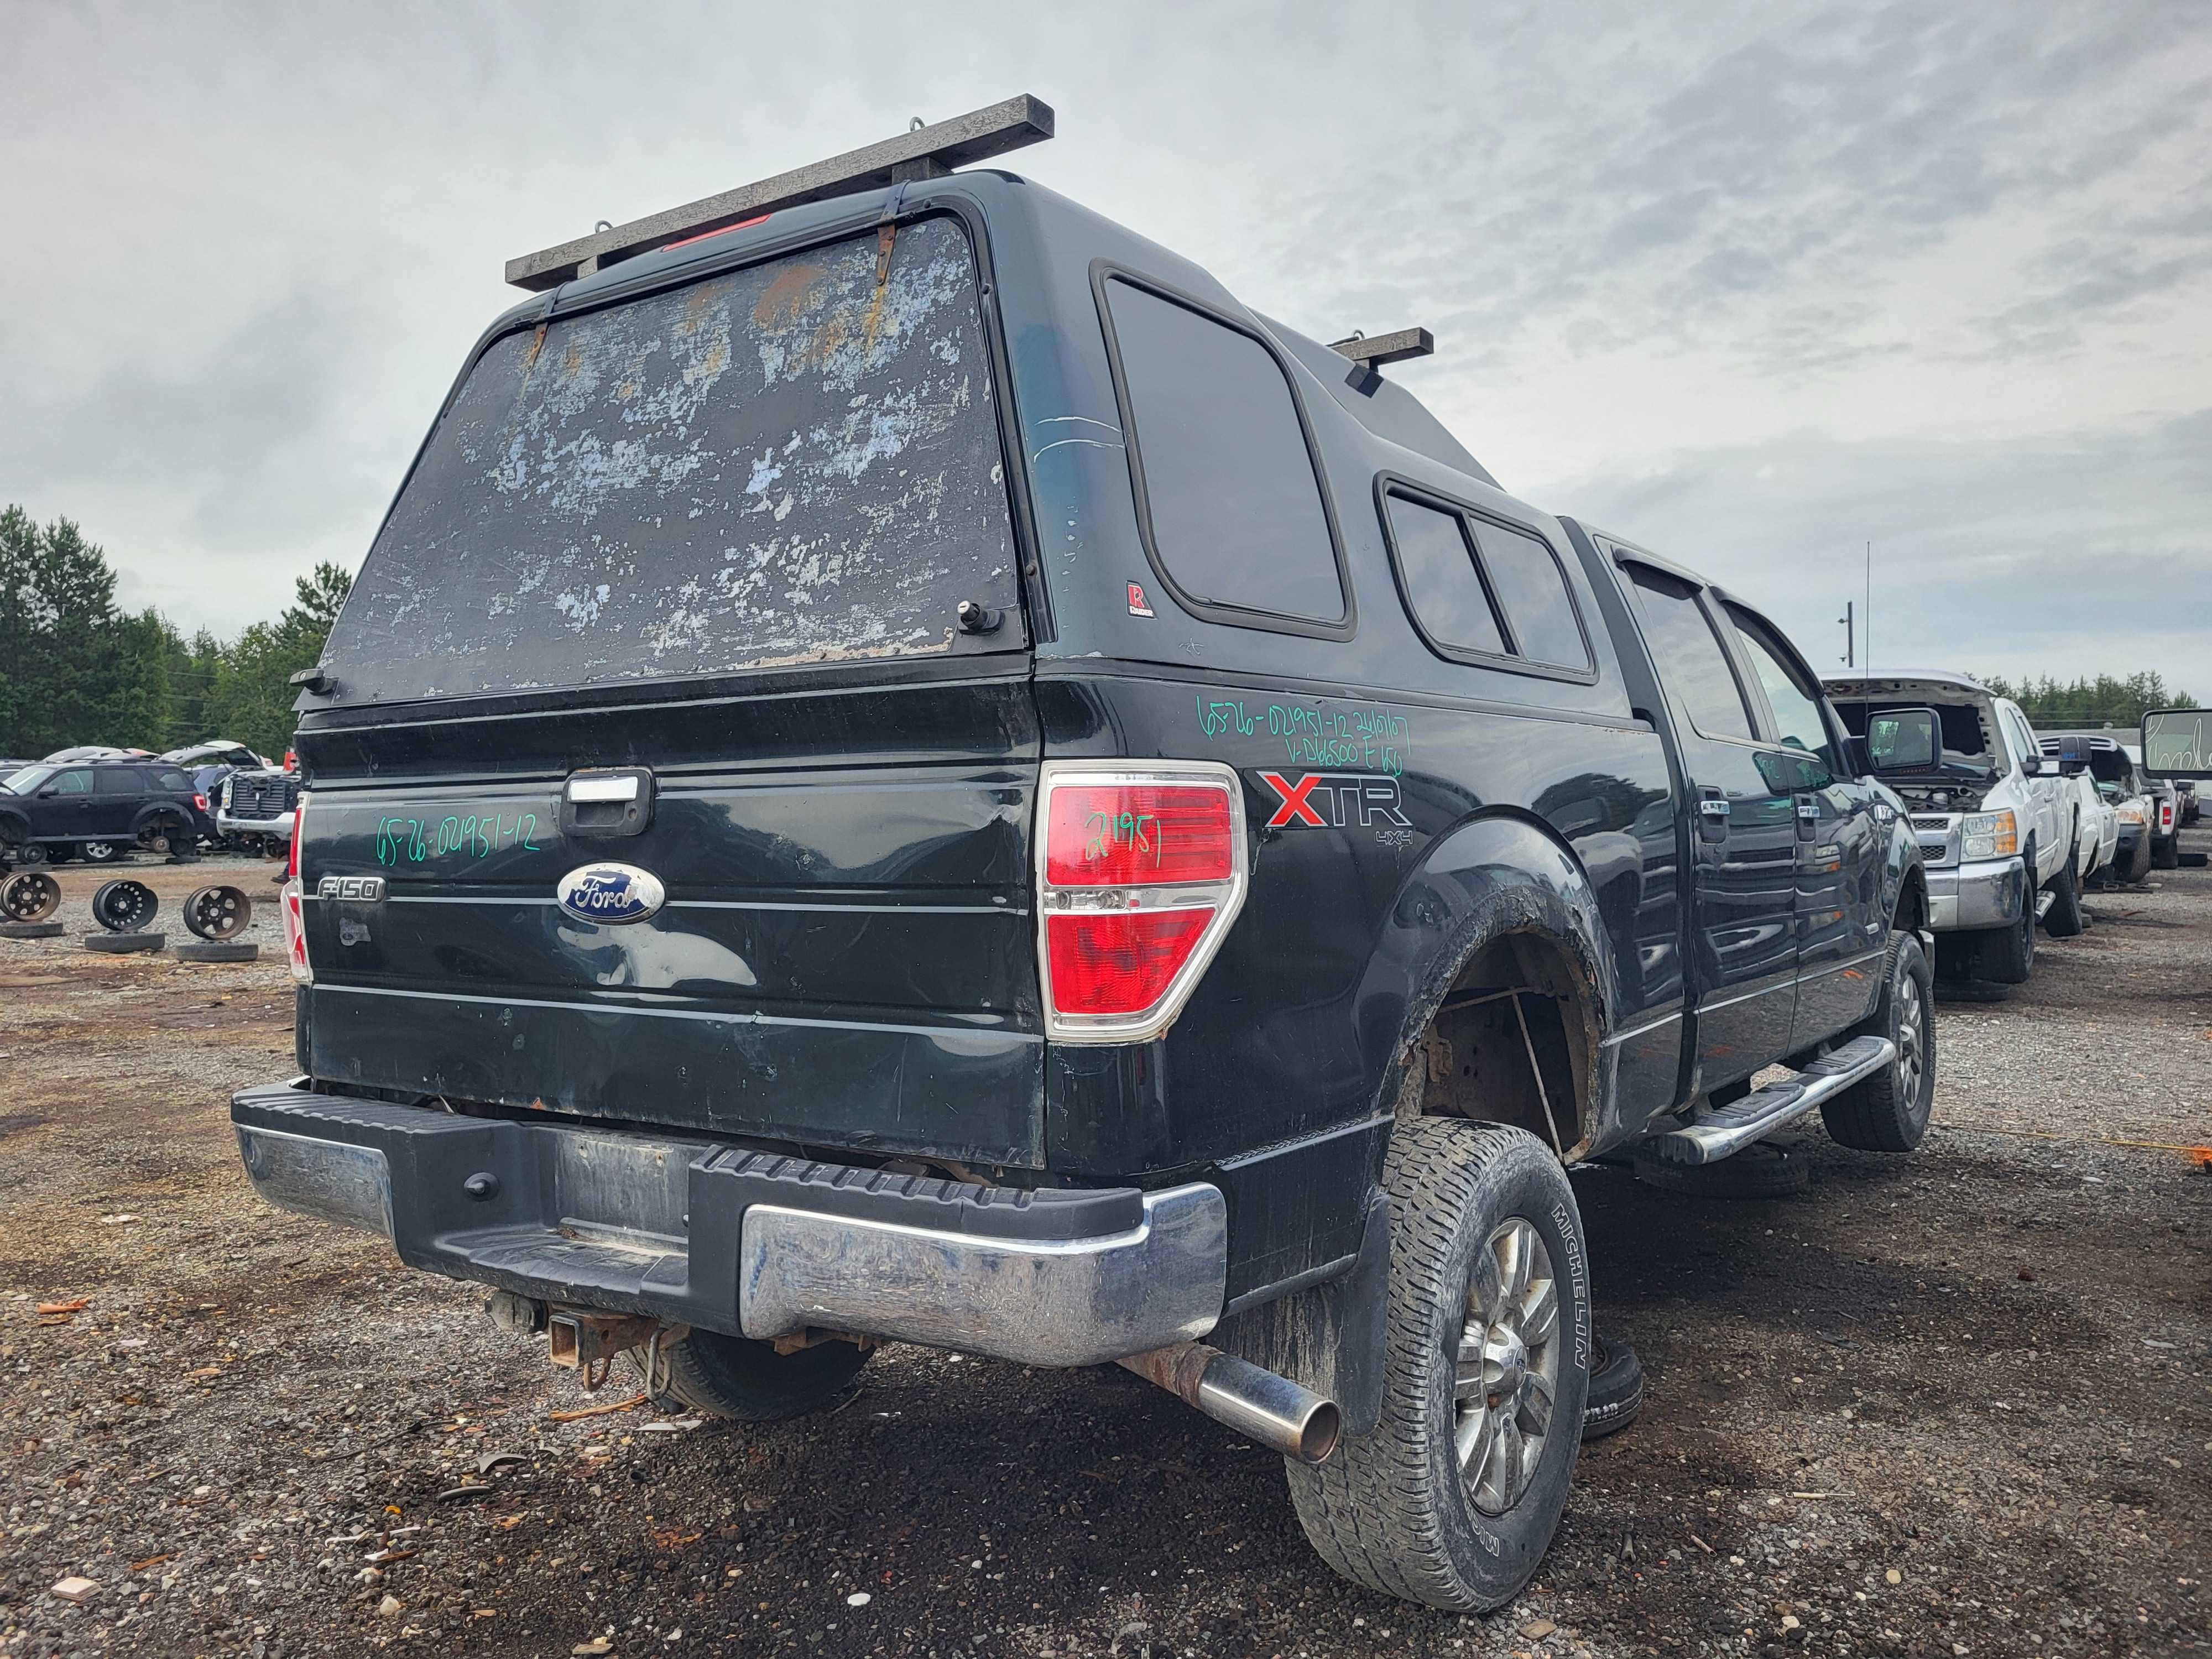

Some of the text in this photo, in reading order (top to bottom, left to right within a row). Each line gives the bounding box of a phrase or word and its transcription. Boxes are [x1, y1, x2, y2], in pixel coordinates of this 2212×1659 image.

[1129, 606, 1154, 617] RAIDER
[1256, 771, 1413, 828] XTR
[575, 875, 630, 909] Ford
[1551, 1202, 1587, 1370] MICHELIN
